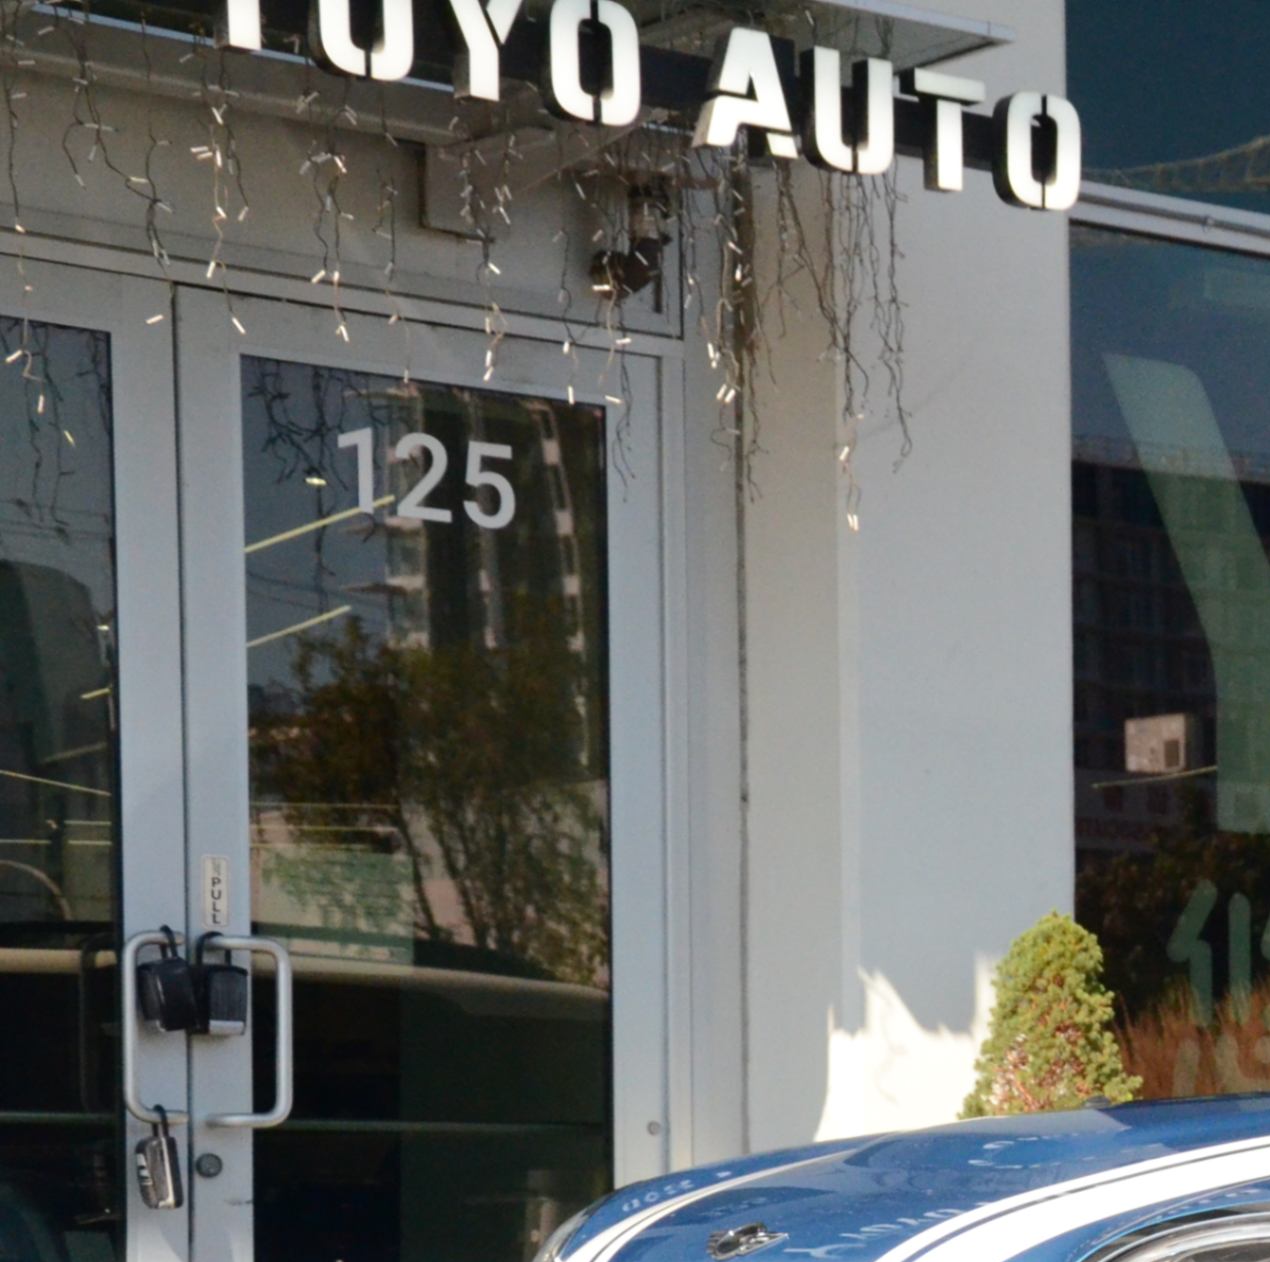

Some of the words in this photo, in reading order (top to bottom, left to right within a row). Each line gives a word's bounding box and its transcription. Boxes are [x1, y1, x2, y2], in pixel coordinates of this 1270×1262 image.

[702, 27, 1081, 211] AUTO
[337, 427, 516, 529] 125
[211, 876, 222, 925] PULL
